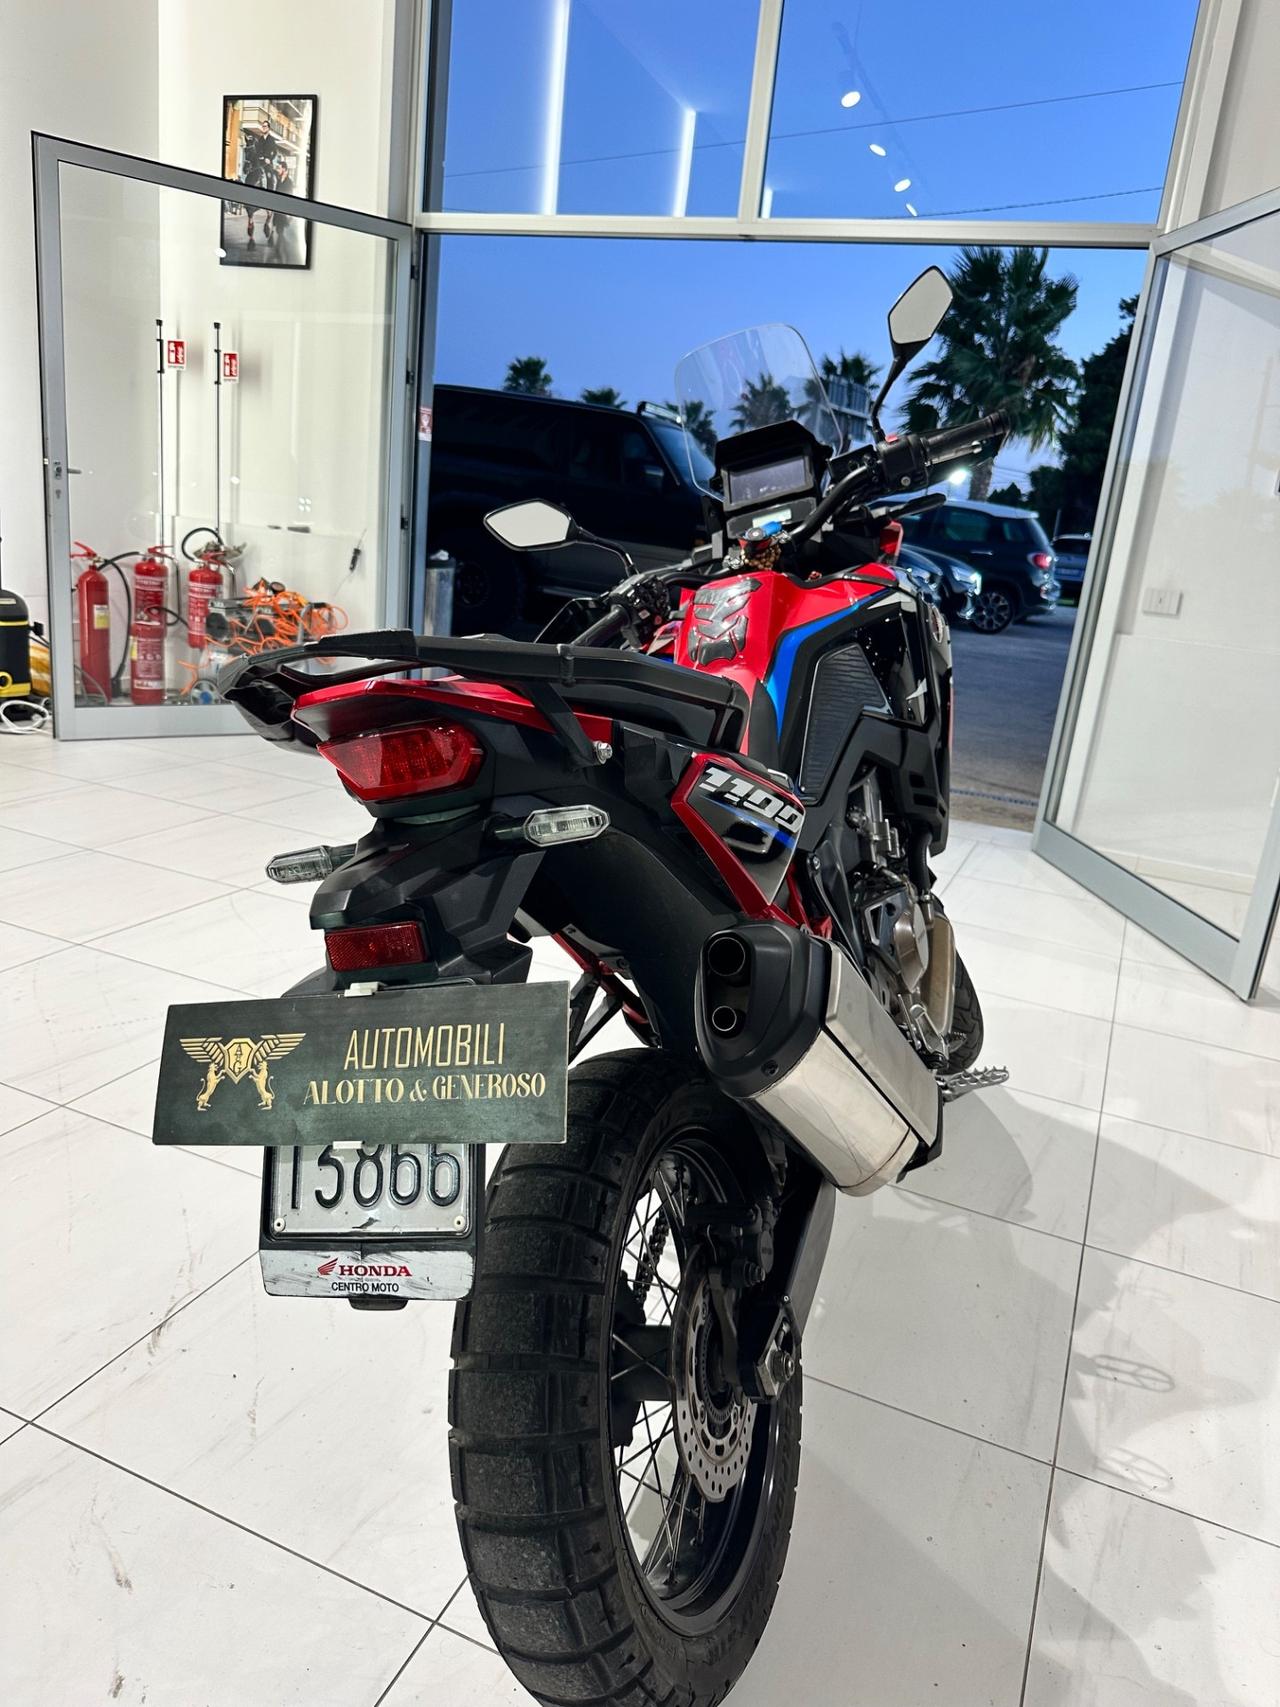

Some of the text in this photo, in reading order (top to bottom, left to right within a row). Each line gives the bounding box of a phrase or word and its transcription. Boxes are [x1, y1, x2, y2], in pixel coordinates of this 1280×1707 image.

[343, 1022, 505, 1070] AUTOMOBILI
[303, 1072, 547, 1105] ALOTTO & GENEROSO
[339, 1264, 412, 1277] HONDA
[331, 1281, 400, 1293] CENTRO MOTO
